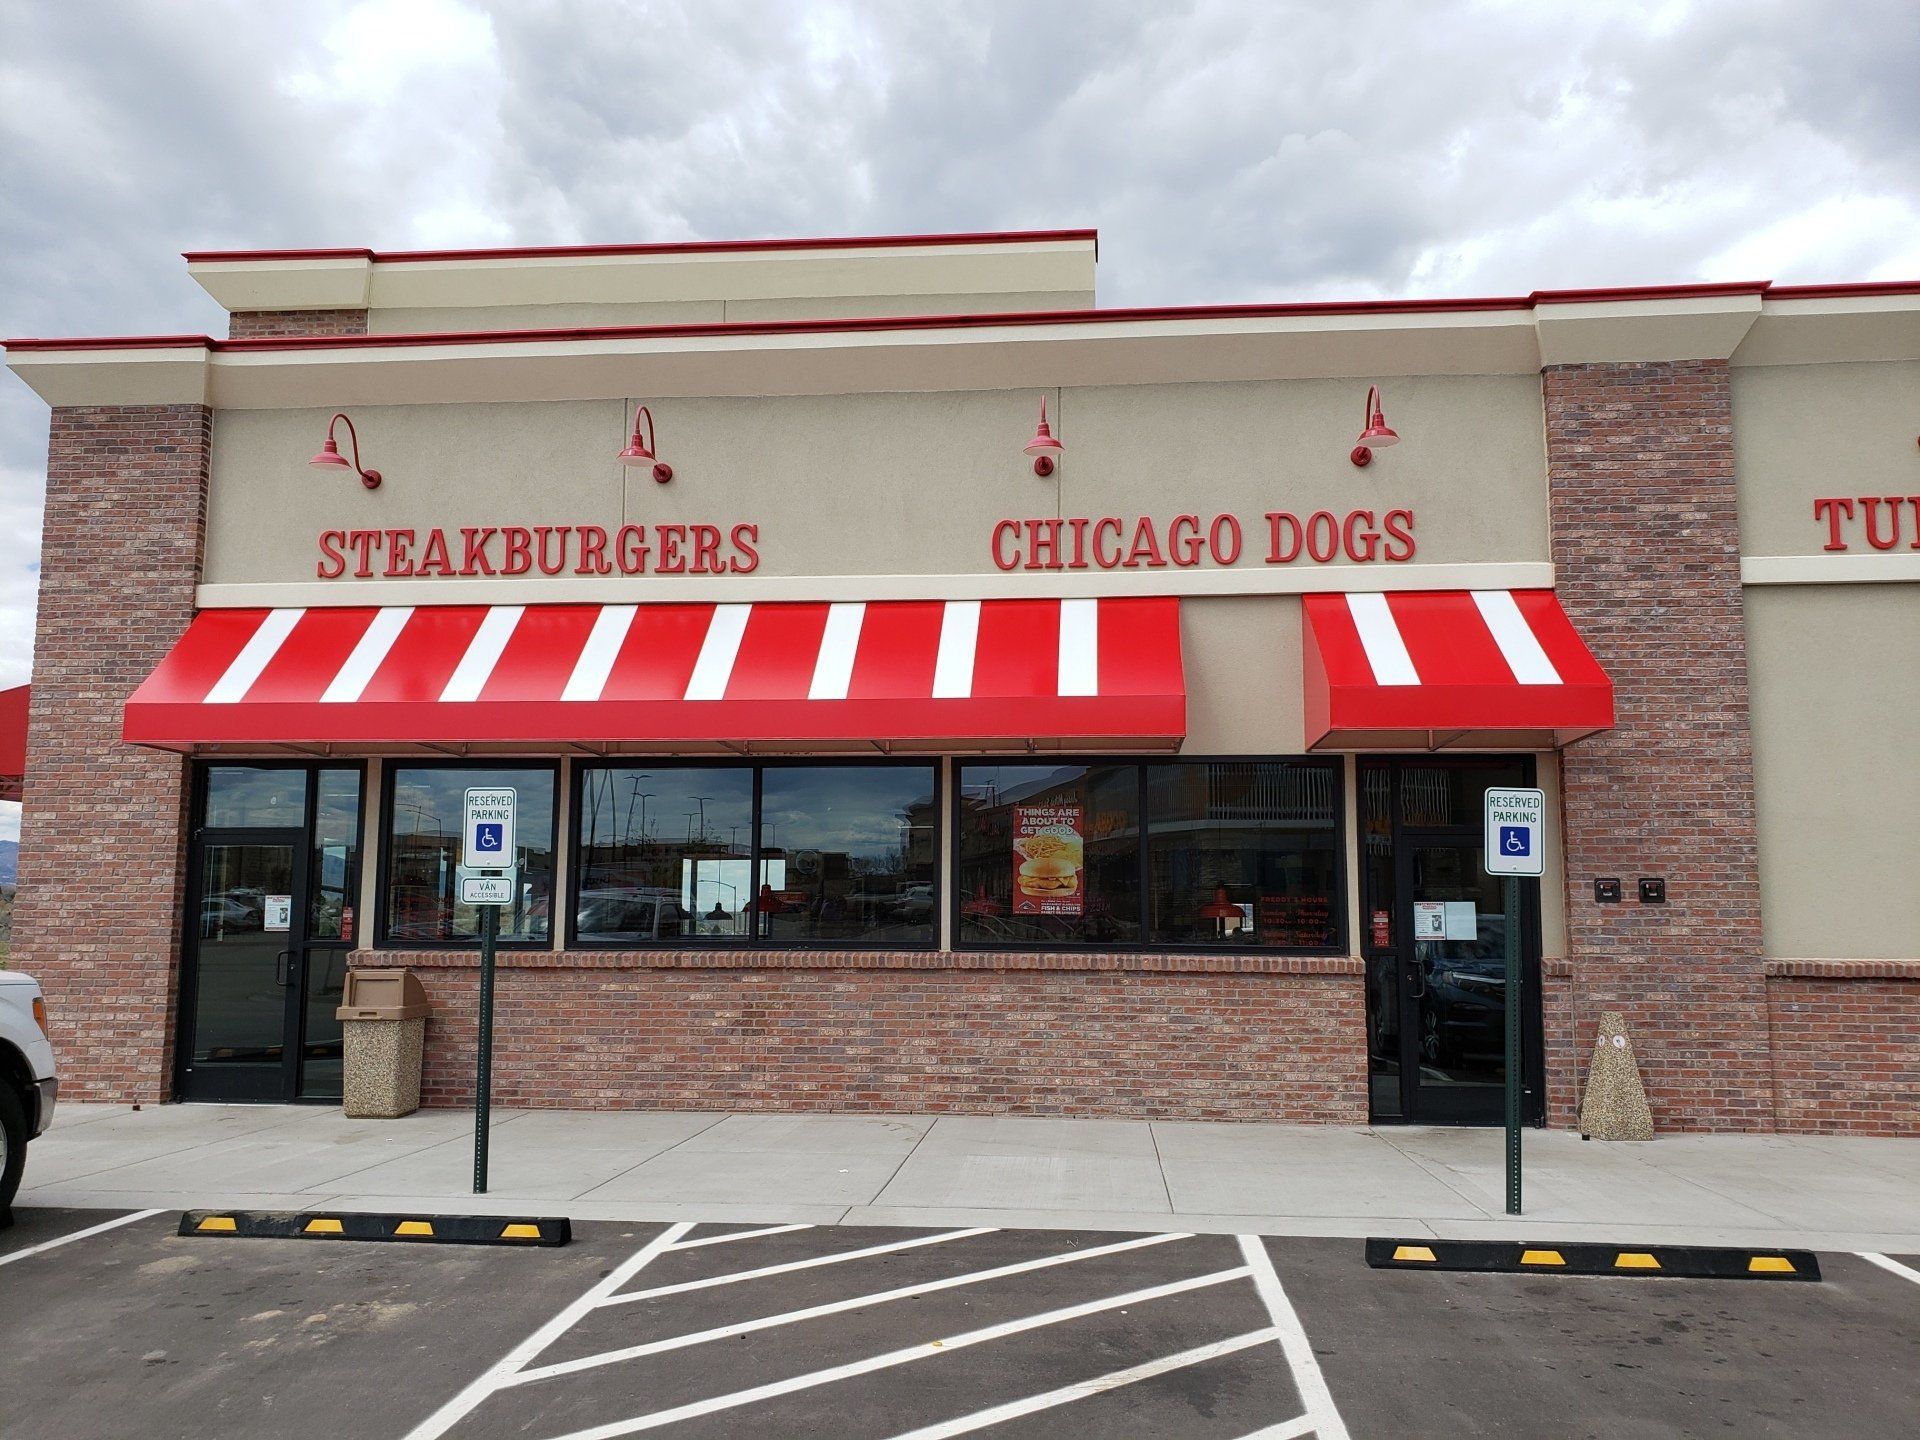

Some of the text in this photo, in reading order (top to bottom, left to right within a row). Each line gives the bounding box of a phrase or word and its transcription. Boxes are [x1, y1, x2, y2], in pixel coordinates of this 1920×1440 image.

[1814, 496, 1920, 551] TU
[992, 510, 1415, 571] CHICAGO DOGS
[318, 523, 759, 578] STEAKBURGERS
[468, 795, 513, 806] RESERVED
[1489, 796, 1540, 808] RESERVED
[471, 809, 509, 820] PARKING
[1017, 808, 1080, 817] THINGS ARE
[1493, 811, 1537, 823] PARKING
[1021, 817, 1075, 826] ABOUT TO
[1020, 826, 1041, 835] GET
[478, 883, 497, 891] VAN
